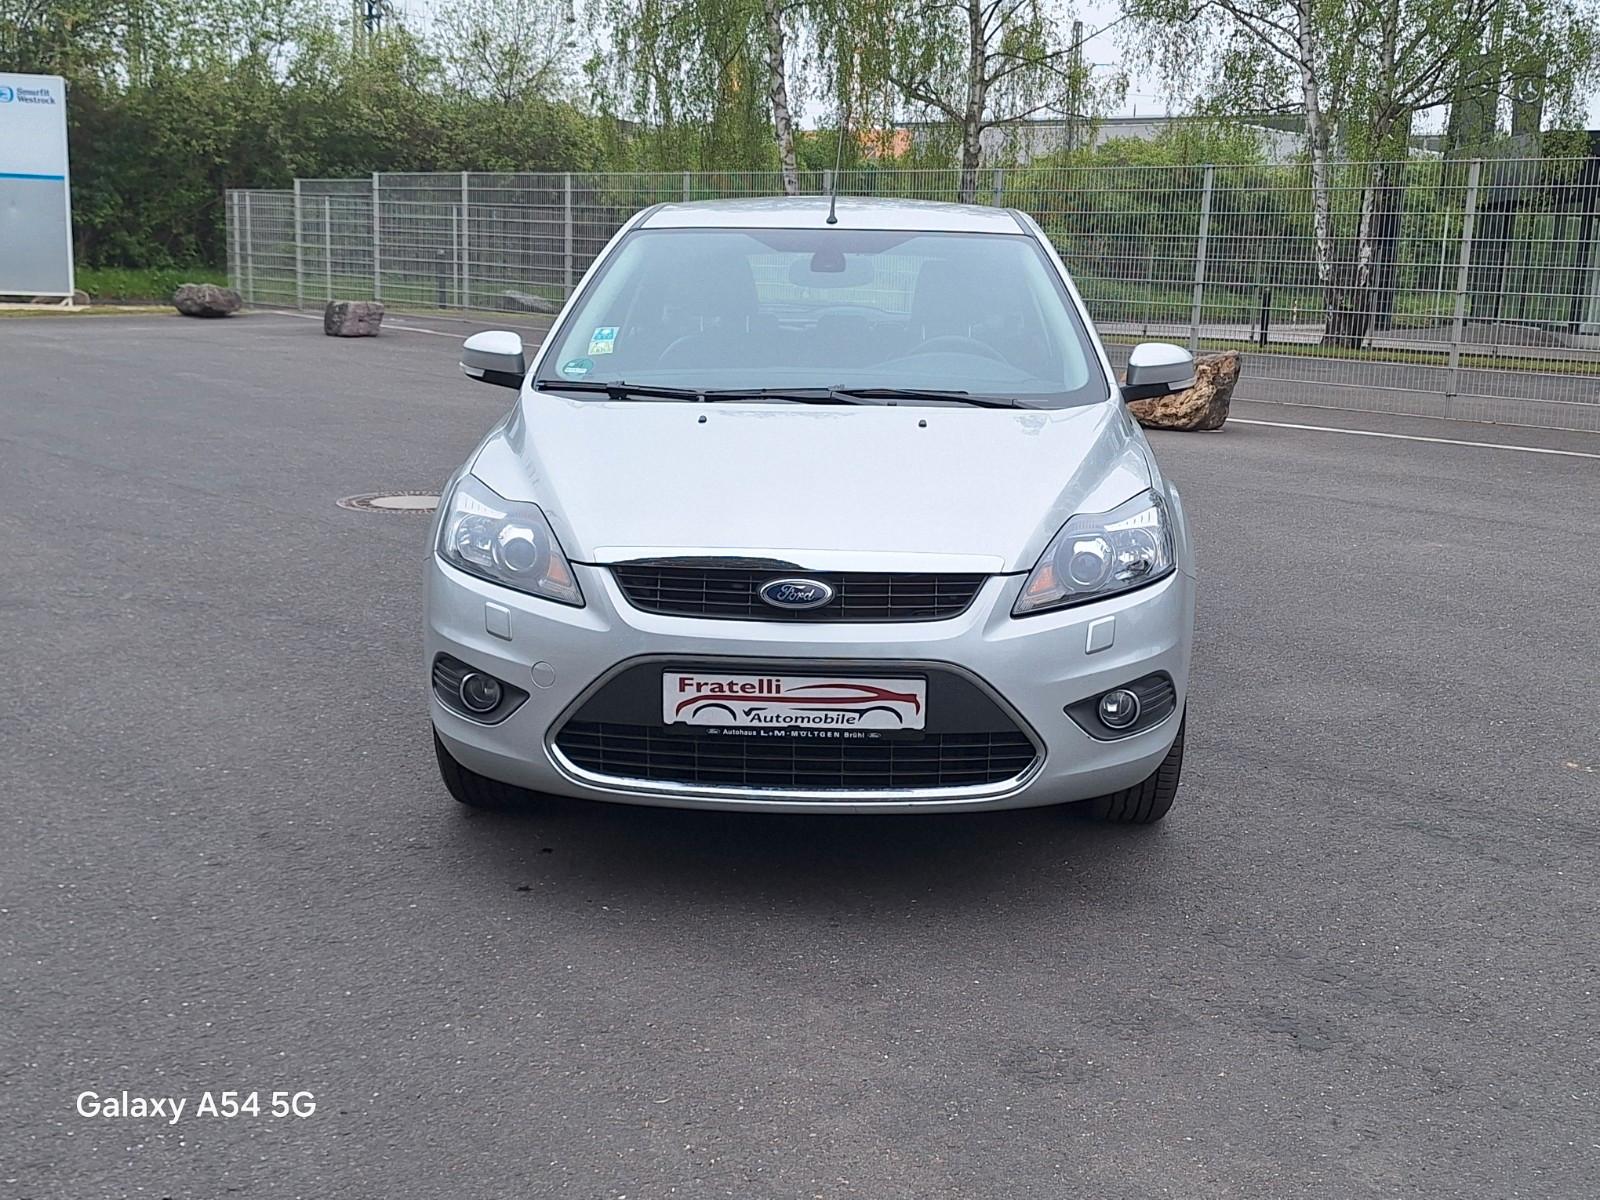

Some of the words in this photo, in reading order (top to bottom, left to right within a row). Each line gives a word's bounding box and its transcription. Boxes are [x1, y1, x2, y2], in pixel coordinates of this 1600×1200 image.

[18, 95, 56, 104] Westrock
[777, 584, 816, 600] Ford
[679, 677, 781, 694] Fratelli
[750, 713, 856, 725] Automobile
[723, 728, 757, 736] Autohaus
